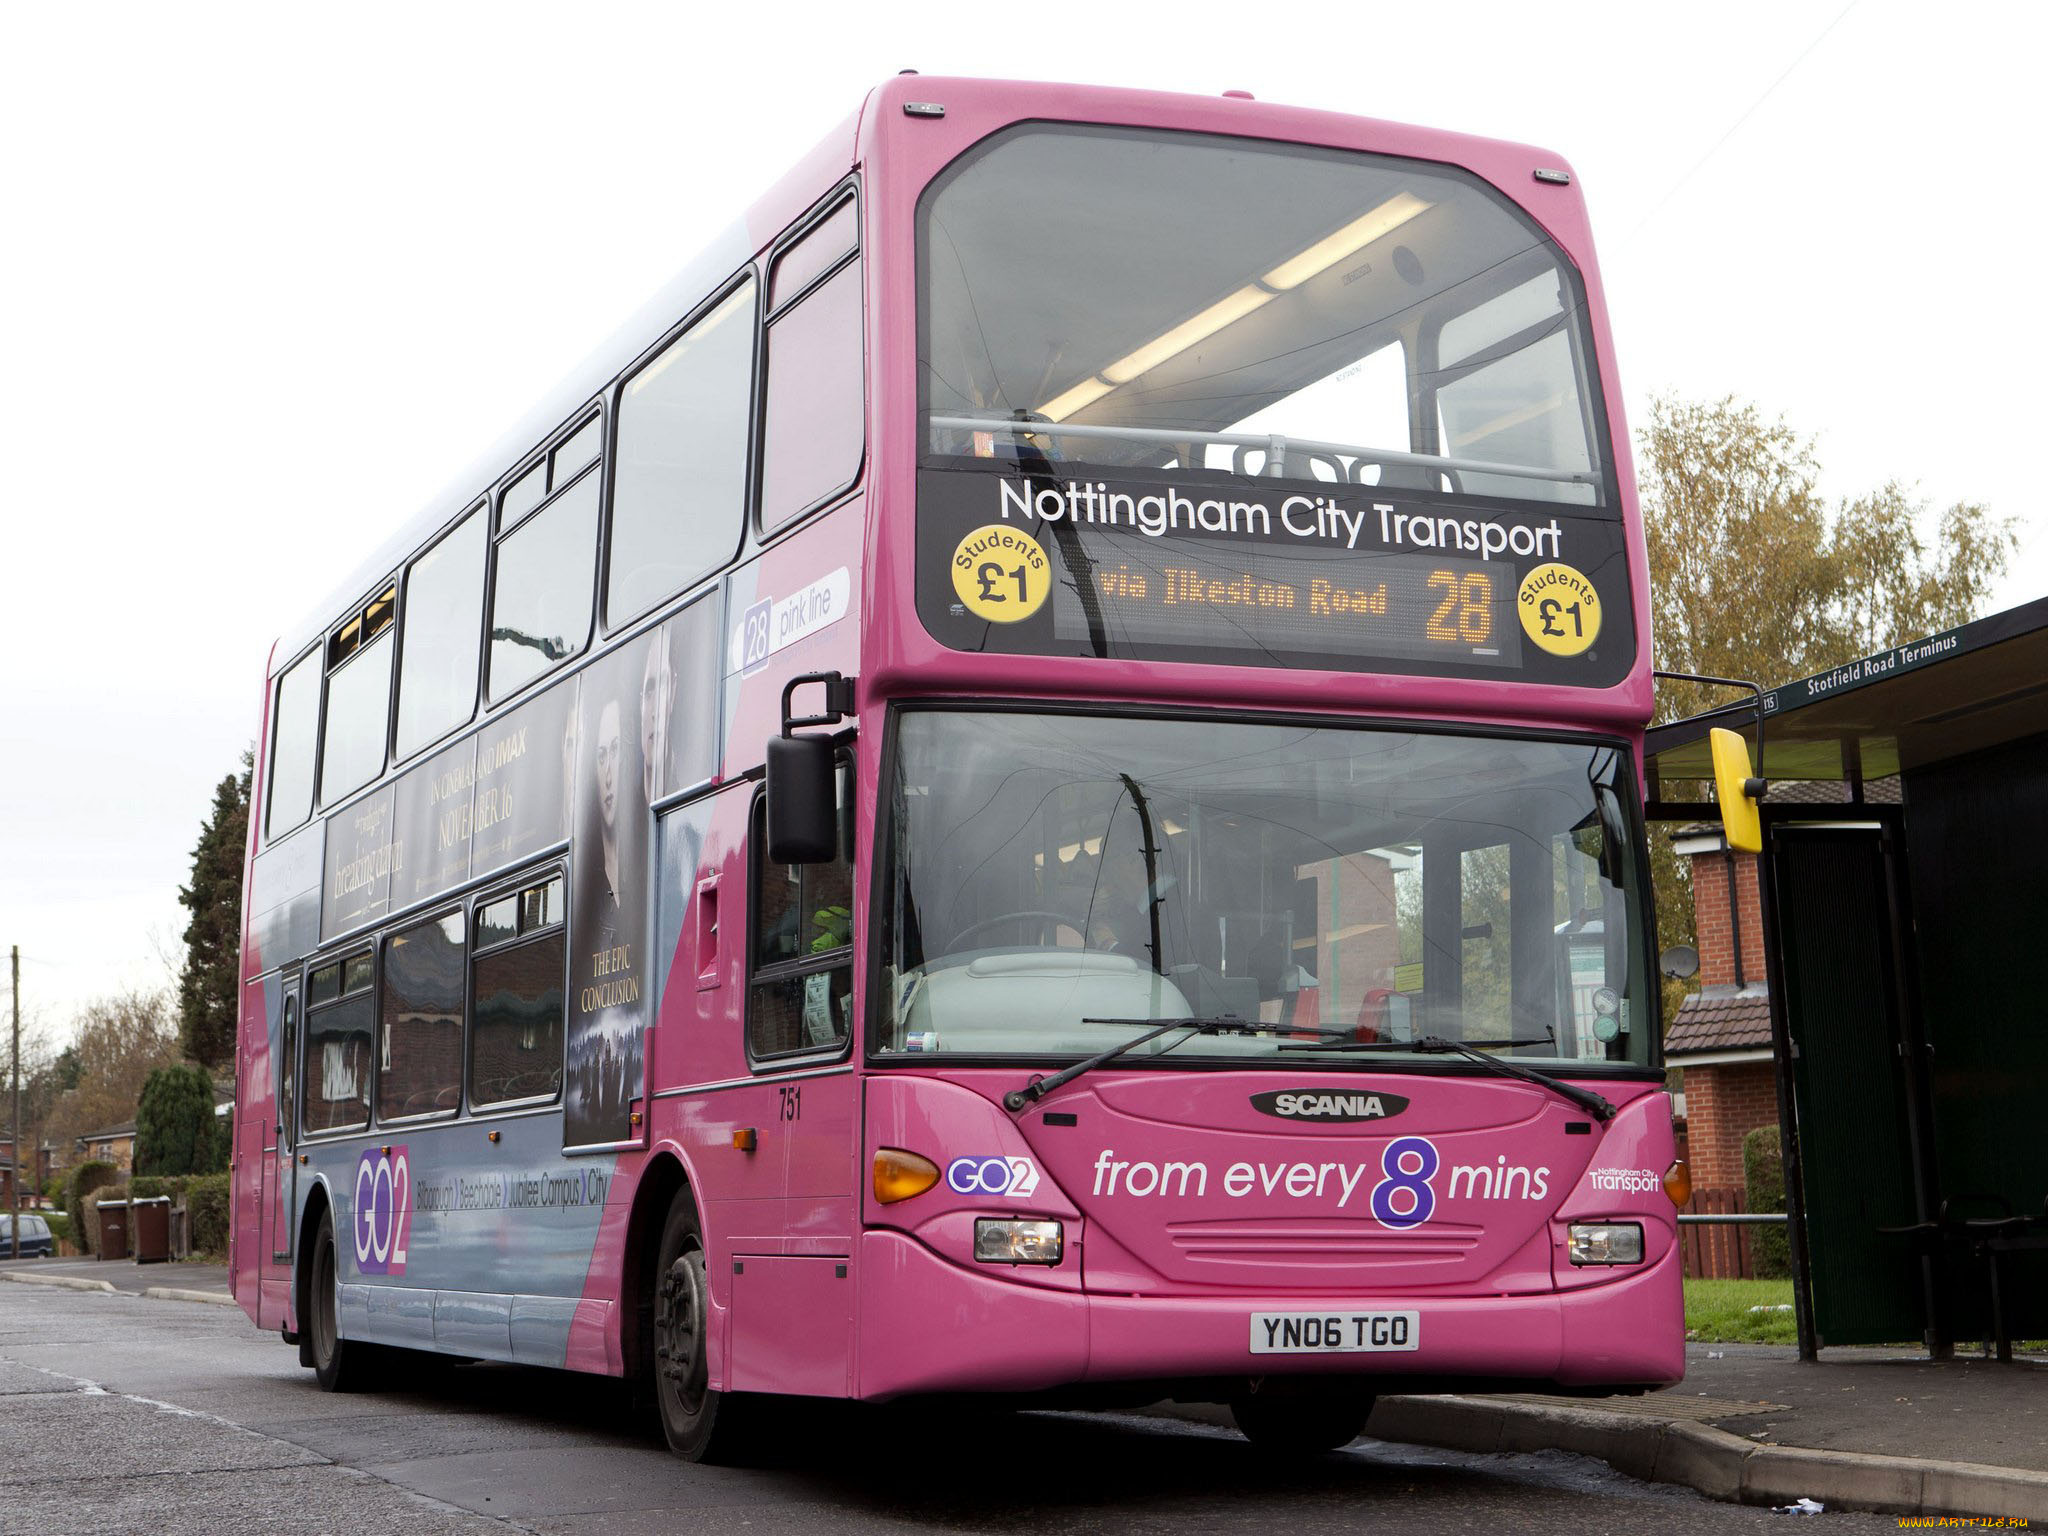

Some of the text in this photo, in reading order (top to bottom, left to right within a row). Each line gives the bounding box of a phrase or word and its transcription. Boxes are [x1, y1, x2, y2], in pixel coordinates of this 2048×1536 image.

[1000, 478, 1562, 560] Nottingham City Transport
[956, 530, 1044, 571] Students
[976, 562, 1028, 603] £1
[1100, 565, 1387, 615] via Ilkeston Road
[1520, 569, 1595, 606] Students
[780, 587, 832, 645] pink line
[1426, 570, 1491, 643] 28
[1539, 598, 1583, 638] £1
[746, 610, 768, 666] 28
[1807, 635, 1958, 696] Stotfield Road Terminus
[496, 727, 528, 768] IMAX
[439, 787, 500, 851] NOVEMBER
[501, 782, 513, 820] 16
[593, 944, 631, 977] THE EPIC
[581, 976, 639, 1013] CONCLUSION
[779, 1087, 801, 1122] 751
[1274, 1093, 1385, 1117] SCANIA
[508, 1172, 539, 1208] Jubilee
[541, 1171, 580, 1213] Campus
[588, 1168, 608, 1212] City
[948, 1157, 1032, 1194] GO2
[1093, 1136, 1551, 1230] from every 8 mins
[1589, 1171, 1659, 1195] Transport
[1597, 1168, 1654, 1177] Nottingham City
[355, 1154, 408, 1264] GO2
[1263, 1316, 1408, 1347] YN06 TGO
